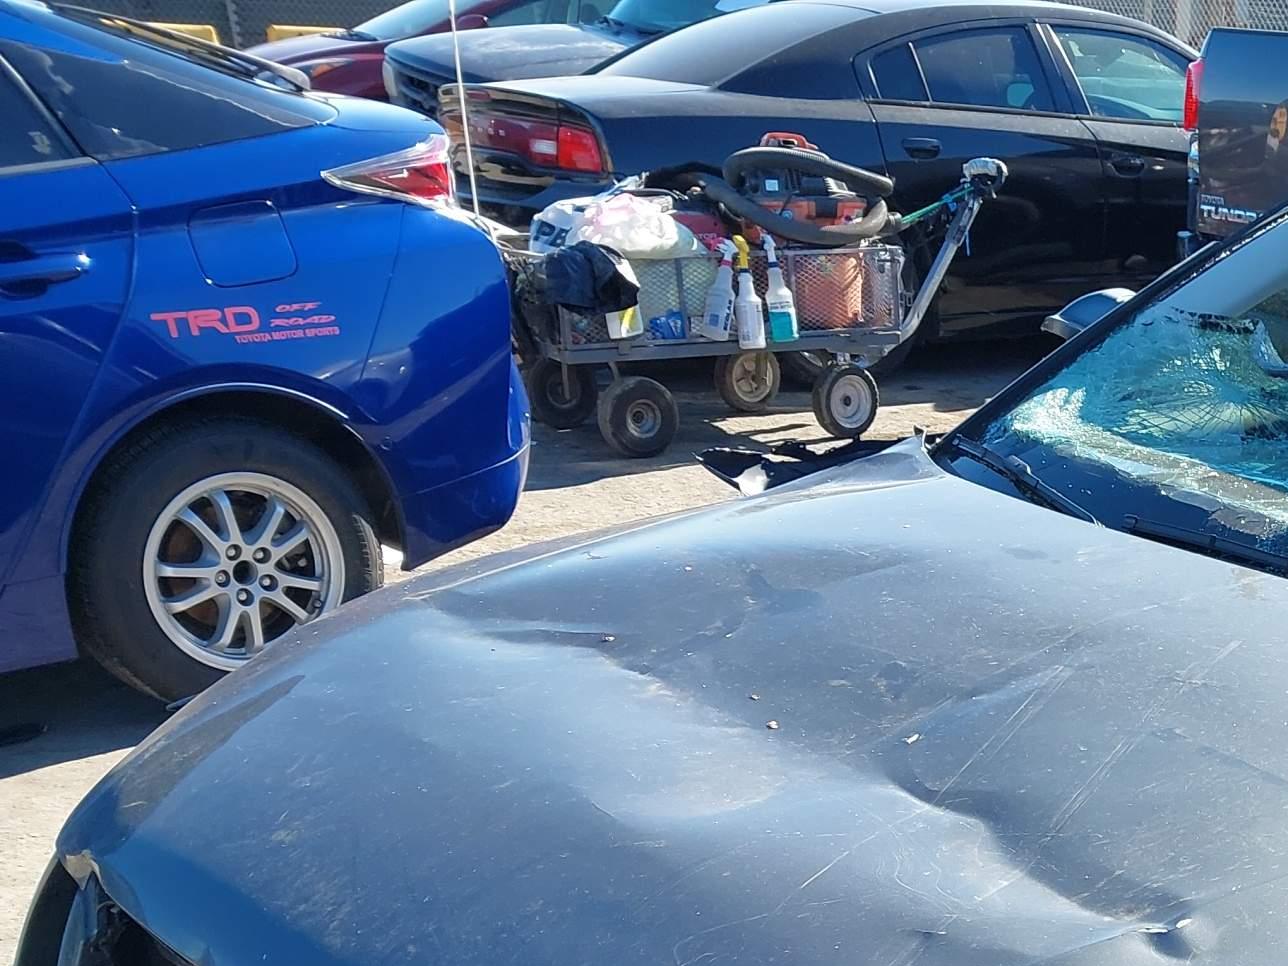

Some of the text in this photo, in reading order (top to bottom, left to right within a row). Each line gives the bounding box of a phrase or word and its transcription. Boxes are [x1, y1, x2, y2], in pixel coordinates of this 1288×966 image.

[1200, 204, 1264, 224] TUNDR
[275, 301, 322, 313] OFF
[150, 306, 260, 338] TRD
[270, 315, 336, 327] ROAD
[235, 326, 340, 344] TOYOTA MOTOR SPORTS
